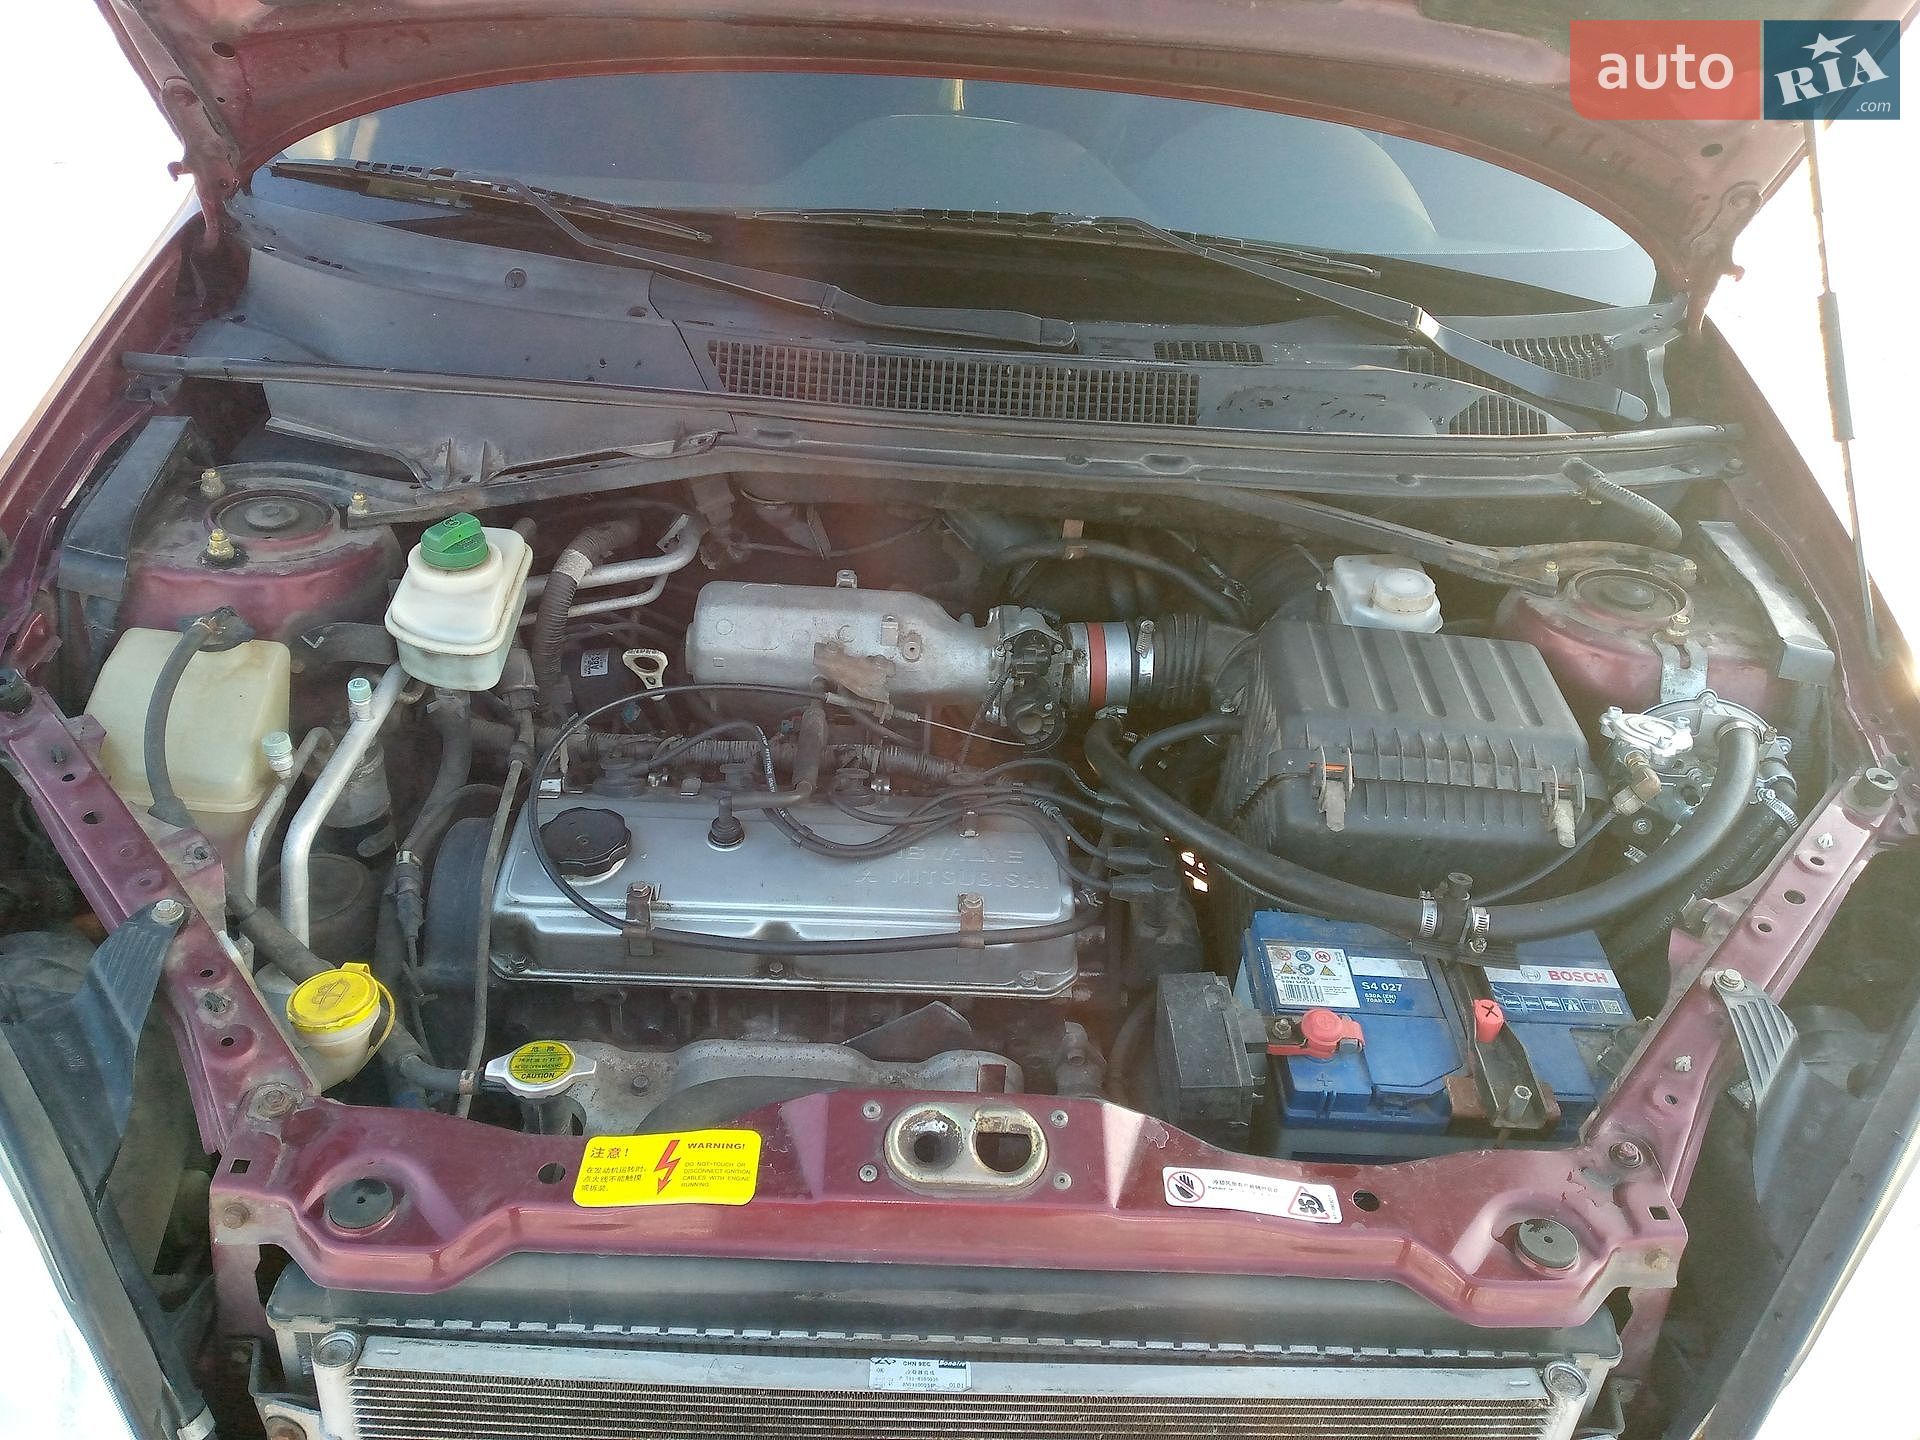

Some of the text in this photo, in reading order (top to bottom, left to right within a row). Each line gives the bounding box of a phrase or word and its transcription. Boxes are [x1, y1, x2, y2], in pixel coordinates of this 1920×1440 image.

[1547, 970, 1609, 984] BOSCH
[1361, 981, 1379, 991] S4
[1380, 982, 1403, 992] 027
[521, 1072, 555, 1080] CAUTION
[687, 1142, 745, 1150] WARNING!
[590, 1147, 629, 1159] 注意！
